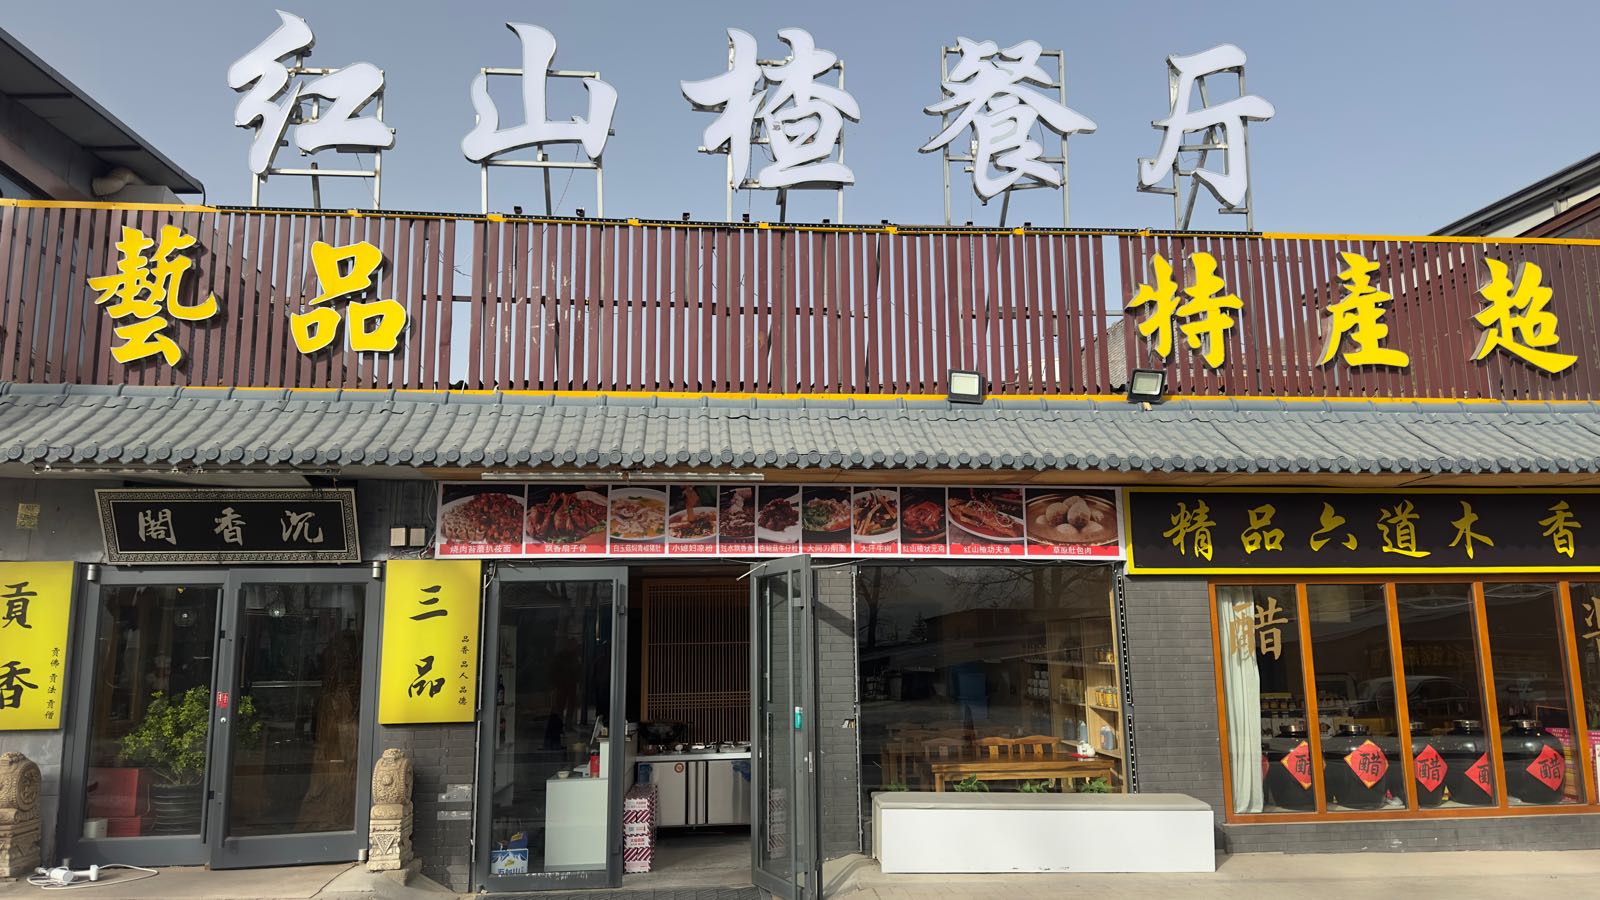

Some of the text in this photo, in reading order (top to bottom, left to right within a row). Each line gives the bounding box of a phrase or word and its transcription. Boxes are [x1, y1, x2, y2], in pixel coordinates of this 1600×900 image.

[227, 9, 1276, 208] 红山楂餐厅
[88, 223, 1579, 373] 藝品 特產超
[408, 585, 448, 698] 三品
[1229, 596, 1290, 662] 醋
[1359, 751, 1382, 777] 醋
[1416, 755, 1442, 782] 醋
[1539, 752, 1561, 779] 醋
